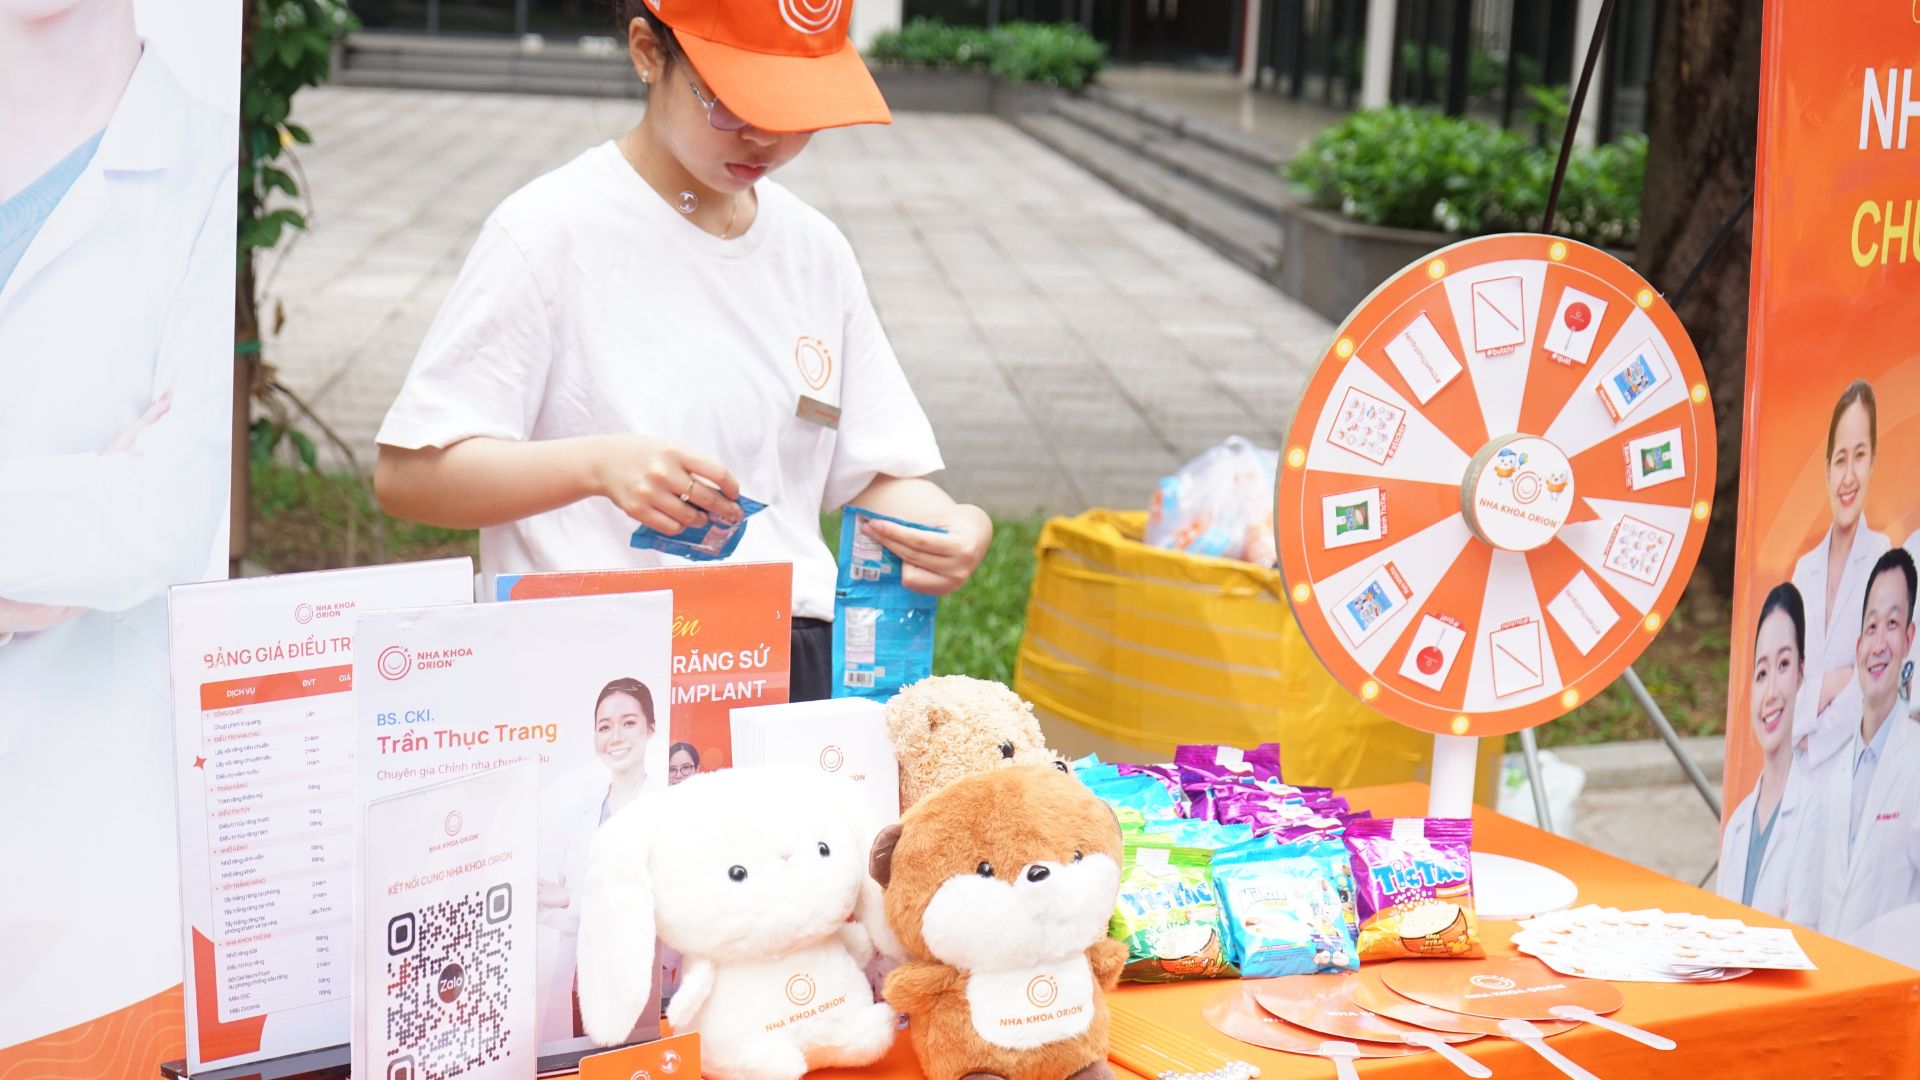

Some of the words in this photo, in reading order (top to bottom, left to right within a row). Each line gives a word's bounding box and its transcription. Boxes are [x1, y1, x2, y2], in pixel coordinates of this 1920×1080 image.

[1851, 200, 1920, 267] CH
[1480, 498, 1498, 510] NHA
[1501, 505, 1526, 519] KHOA
[1528, 513, 1557, 528] ORION
[315, 610, 341, 619] ORION
[316, 604, 332, 612] NHA
[334, 601, 356, 609] KHOA
[255, 640, 284, 663] GIÁ
[329, 636, 353, 653] TR
[417, 651, 440, 660] NHA
[443, 648, 473, 657] KHOA
[672, 648, 734, 674] RĂNG
[739, 642, 771, 669] SỨ
[417, 660, 453, 670] ORION
[226, 688, 244, 698] DỊCH
[244, 687, 256, 697] VỤ
[671, 679, 767, 705] IMPLANT
[377, 713, 401, 726] BS.
[404, 709, 435, 724] CKI.
[377, 729, 428, 754] Trần
[434, 730, 490, 751] Thục
[495, 723, 557, 743] Trang
[377, 769, 416, 781] Chuyên
[471, 760, 490, 770] nha
[446, 866, 463, 878] NHA
[464, 859, 487, 873] KHOA
[440, 976, 462, 992] Zalo
[765, 1020, 785, 1032] NHA
[789, 1008, 817, 1024] KHOA
[818, 996, 845, 1013] ORION
[1000, 1018, 1023, 1026] NHA
[1026, 1013, 1054, 1024] KHOA
[1056, 1005, 1083, 1018] ORION
